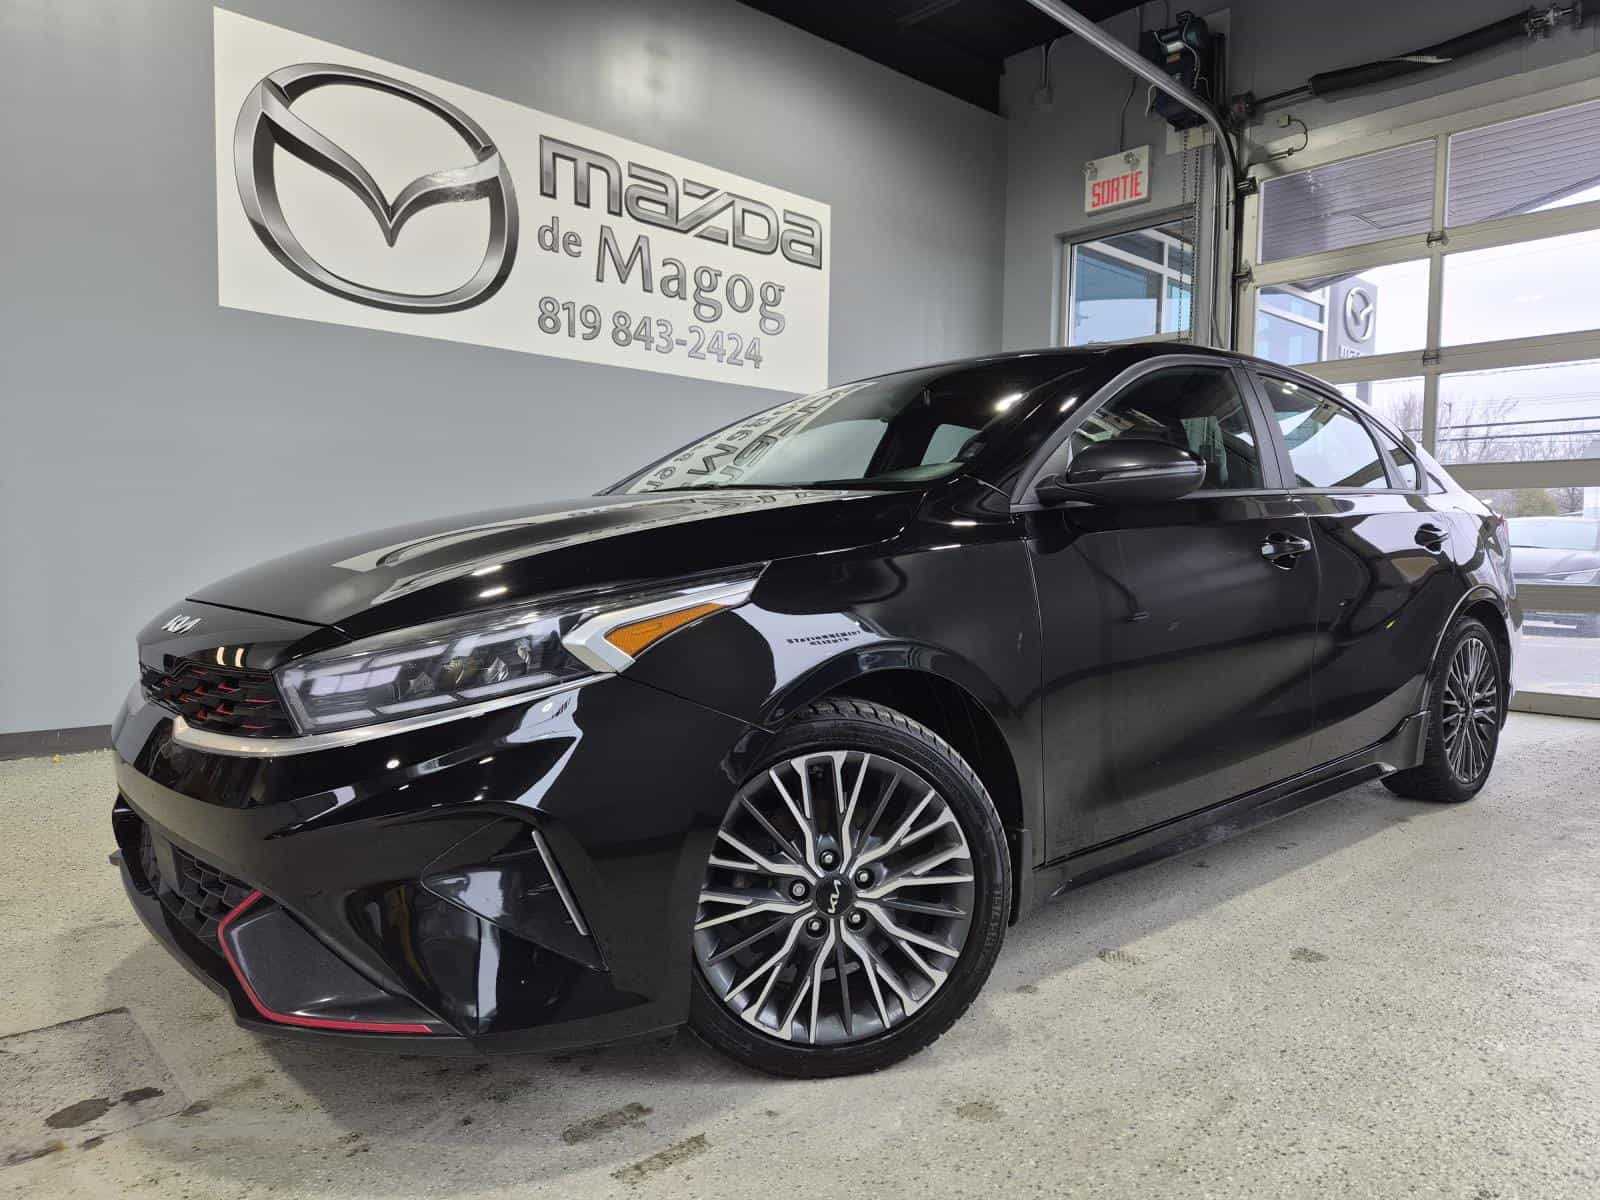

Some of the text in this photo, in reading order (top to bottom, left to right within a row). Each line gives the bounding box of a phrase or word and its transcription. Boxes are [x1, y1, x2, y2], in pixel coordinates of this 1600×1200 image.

[1091, 170, 1143, 208] SORTIE
[537, 216, 786, 335] de Magog
[537, 297, 763, 369] 819 843-2424
